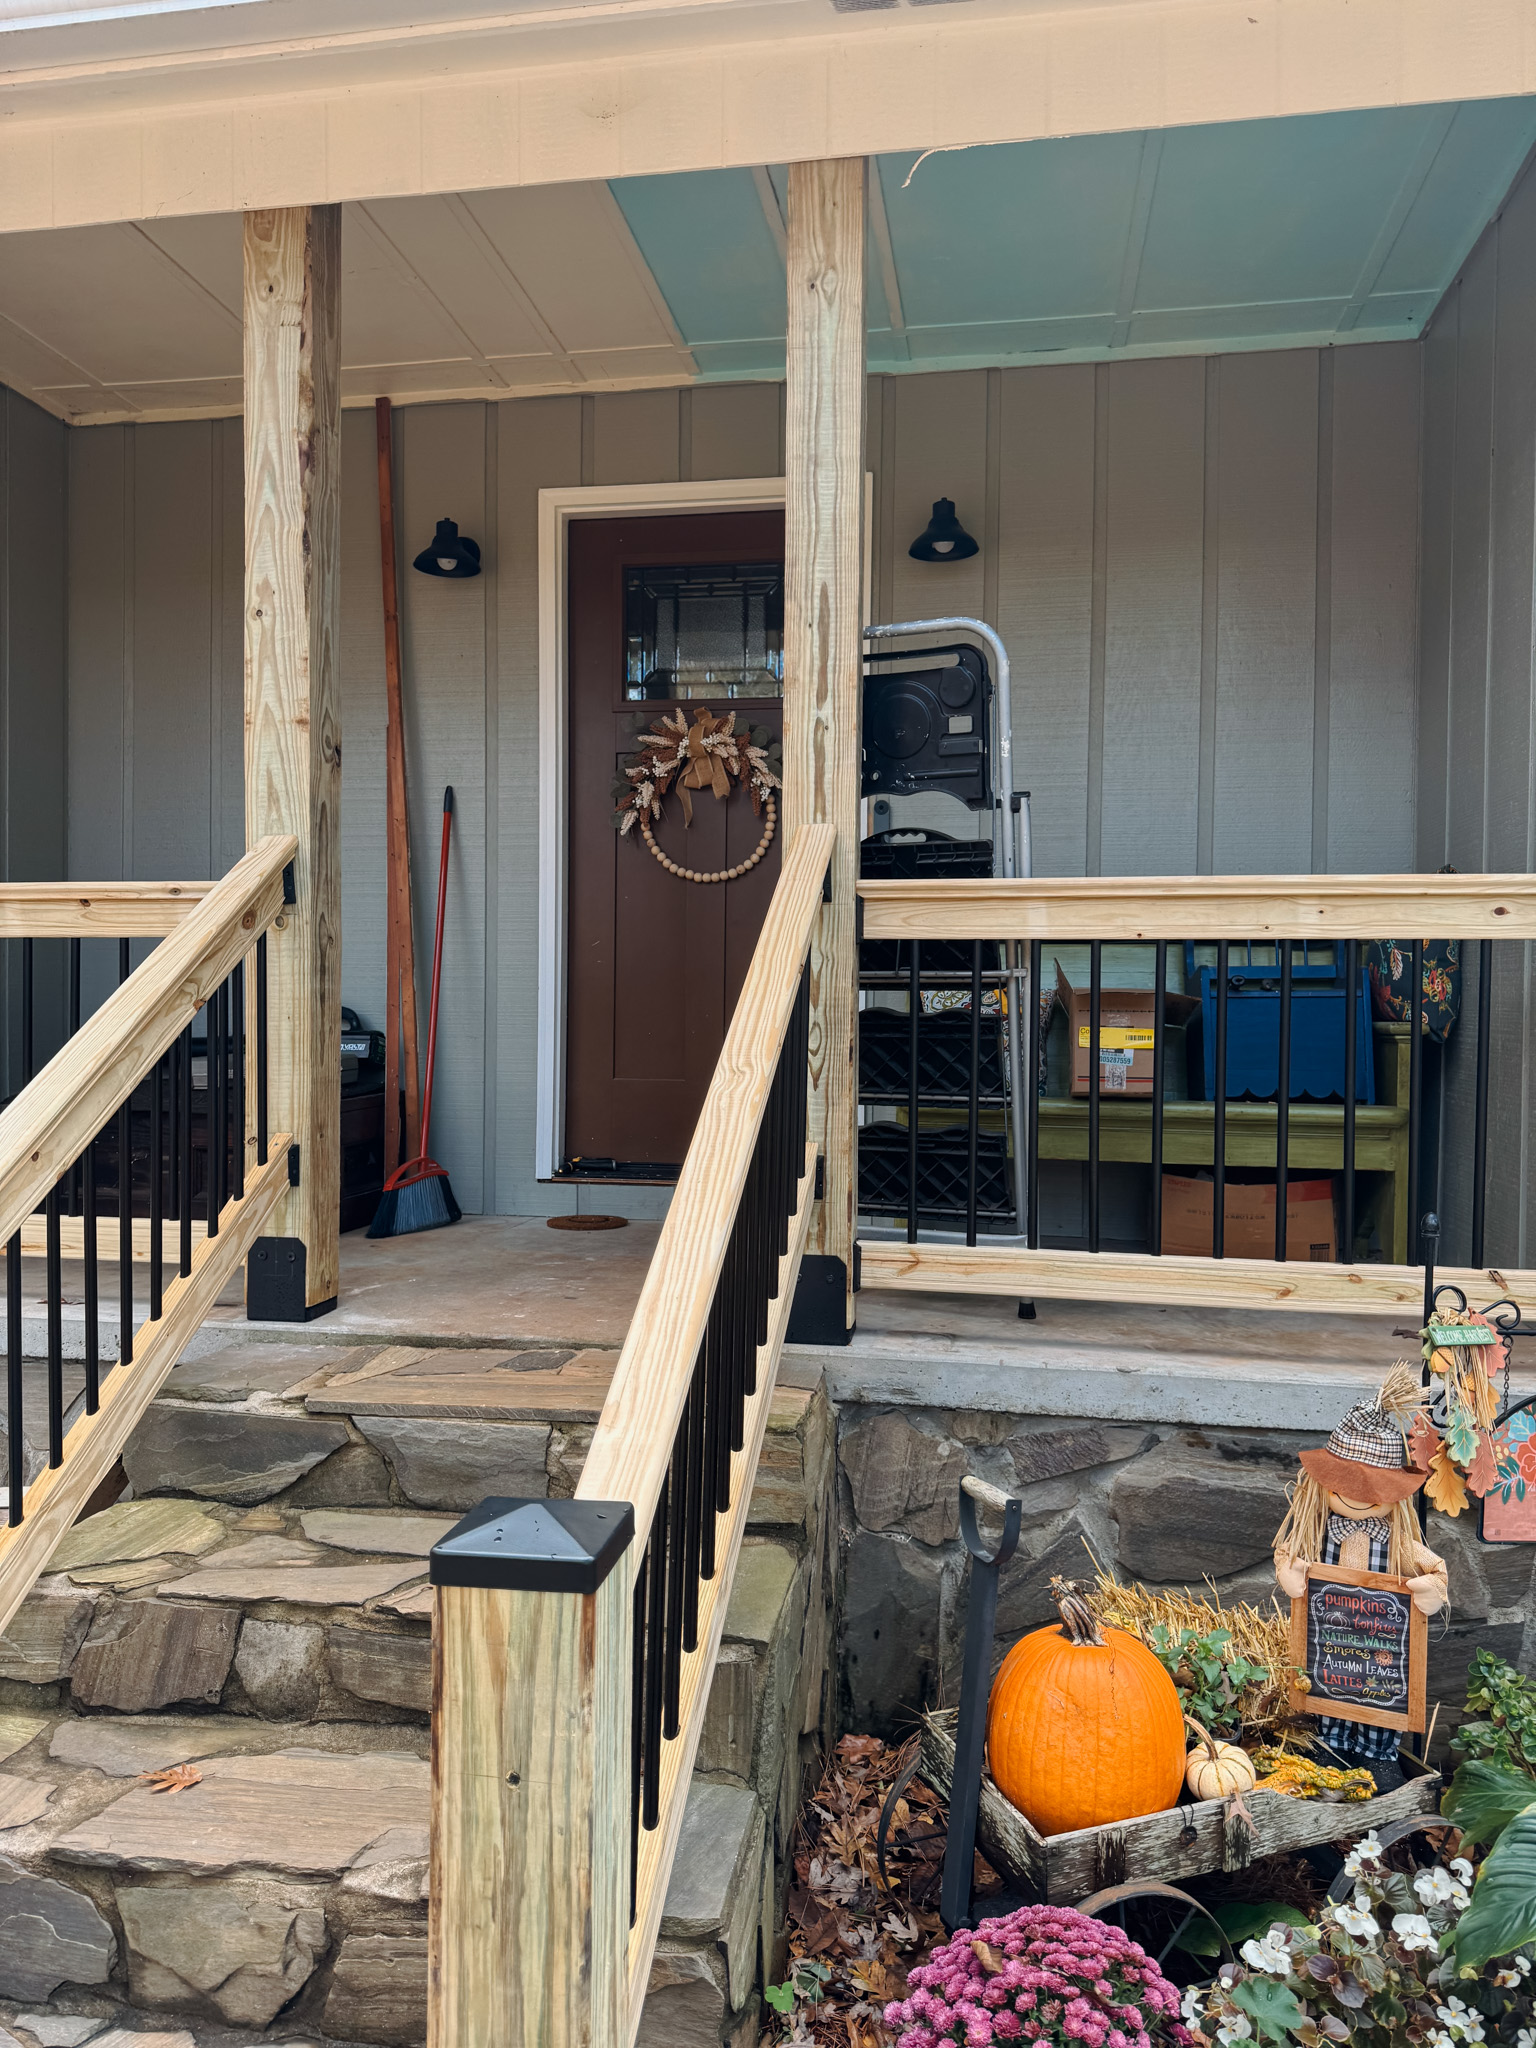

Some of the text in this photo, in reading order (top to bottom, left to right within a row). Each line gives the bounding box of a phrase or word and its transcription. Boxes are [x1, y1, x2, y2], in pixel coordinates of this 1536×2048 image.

[1435, 1329, 1465, 1343] WELCOME
[1326, 1593, 1386, 1616] pumpkins
[1353, 1614, 1398, 1635] bonfires
[1321, 1630, 1399, 1652] NATURE WALKS
[1323, 1669, 1363, 1688] LATTES
[1366, 1661, 1399, 1677] LEAVES
